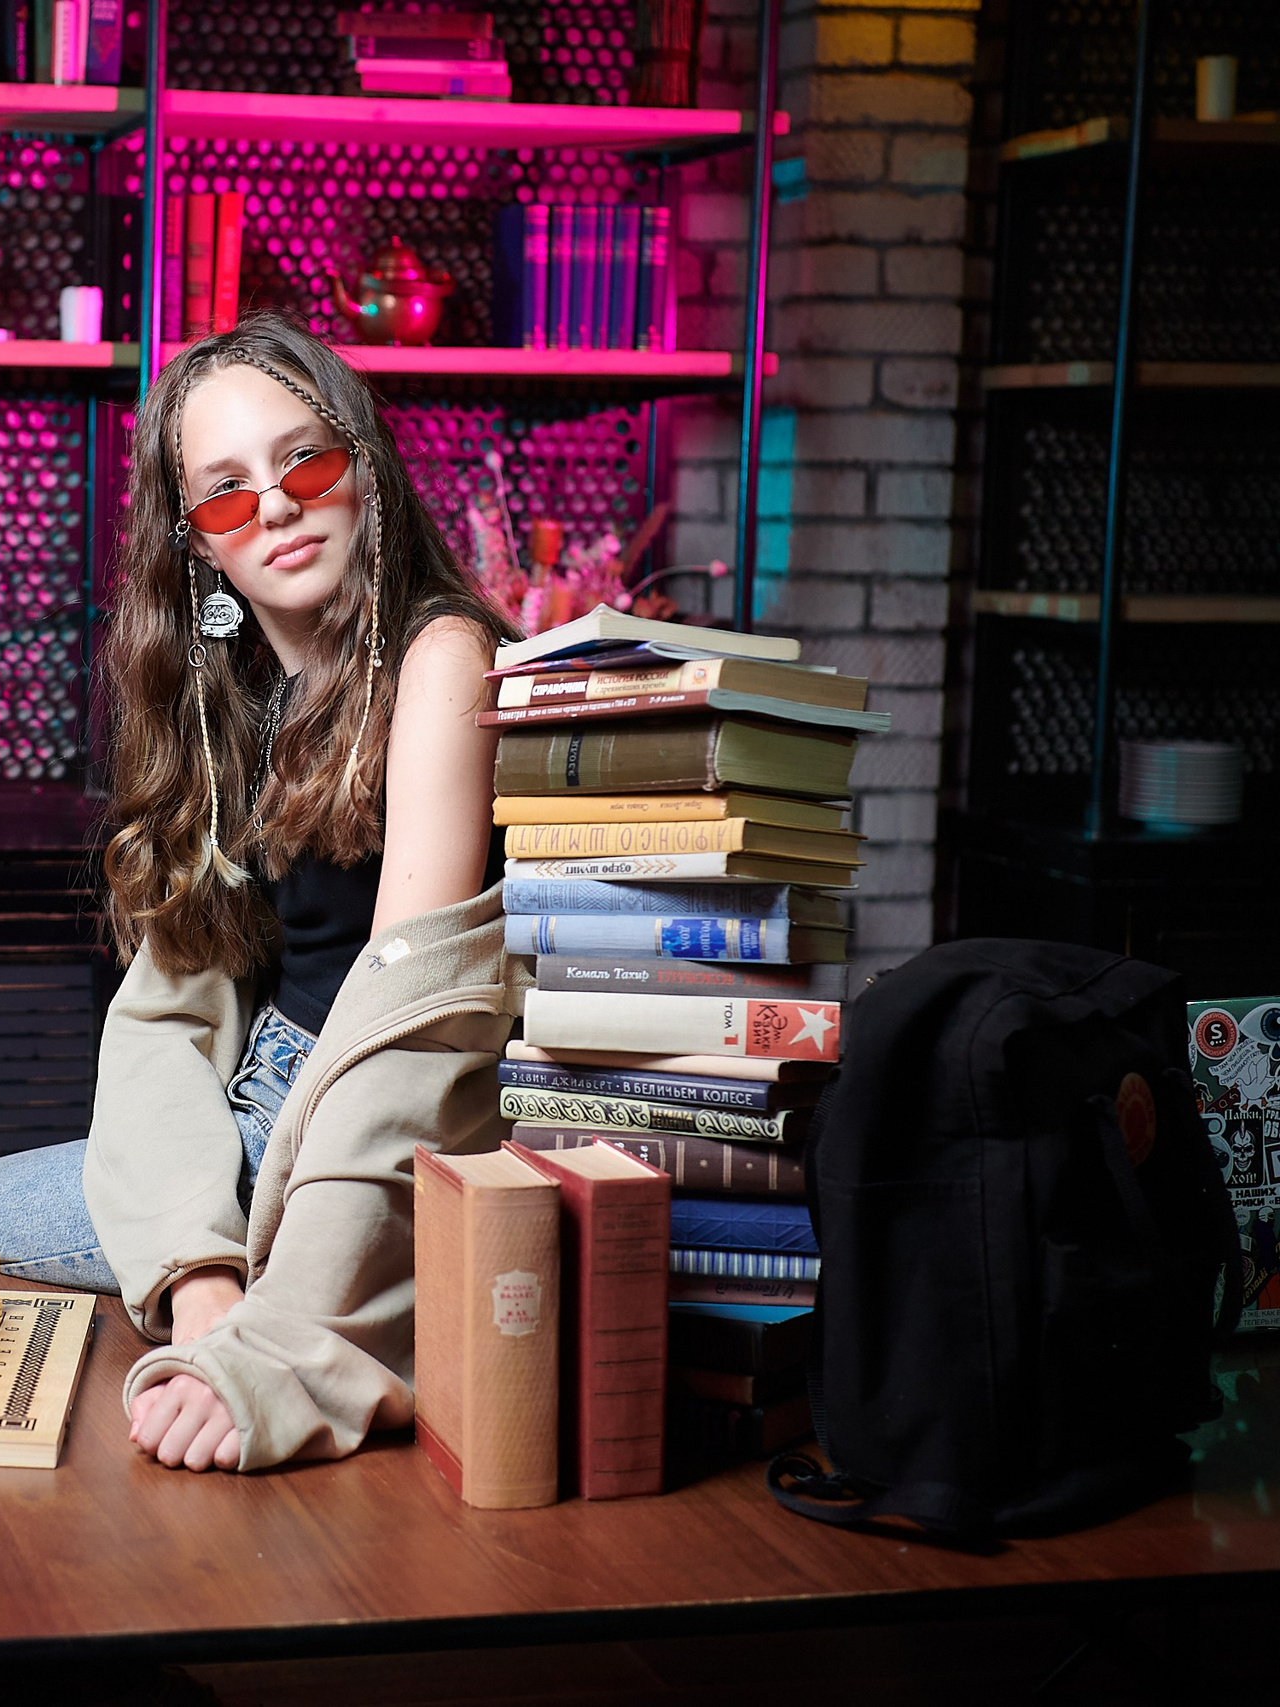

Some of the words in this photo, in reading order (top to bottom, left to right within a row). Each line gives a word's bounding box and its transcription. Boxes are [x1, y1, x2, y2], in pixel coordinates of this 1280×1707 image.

[597, 673, 634, 684] ИСТОРИЯ
[635, 671, 669, 682] РОССИИ
[532, 681, 587, 696] СПРАВОЧНИК
[497, 710, 526, 720] Геометрия
[517, 827, 605, 854] ШМИДТ
[619, 826, 728, 852] АФОНСО
[564, 863, 599, 876] ШУМИТ
[602, 862, 632, 874] ОЗЕРО
[677, 925, 691, 951] ДОМ
[699, 920, 714, 957] РОДНОЙ
[566, 968, 611, 980] Кемаль
[614, 968, 650, 982] Тахир
[753, 1021, 762, 1045] ВИЧ
[1210, 1023, 1223, 1040] S
[724, 1033, 739, 1046] 1
[551, 1076, 613, 1091] ДЖИЛБЕРТ
[623, 1081, 630, 1092] В
[634, 1082, 697, 1100] БЕЛИЧЬЕМ
[703, 1089, 754, 1106] КОЛЕСЕ
[1235, 1187, 1277, 1198] НАШИХ
